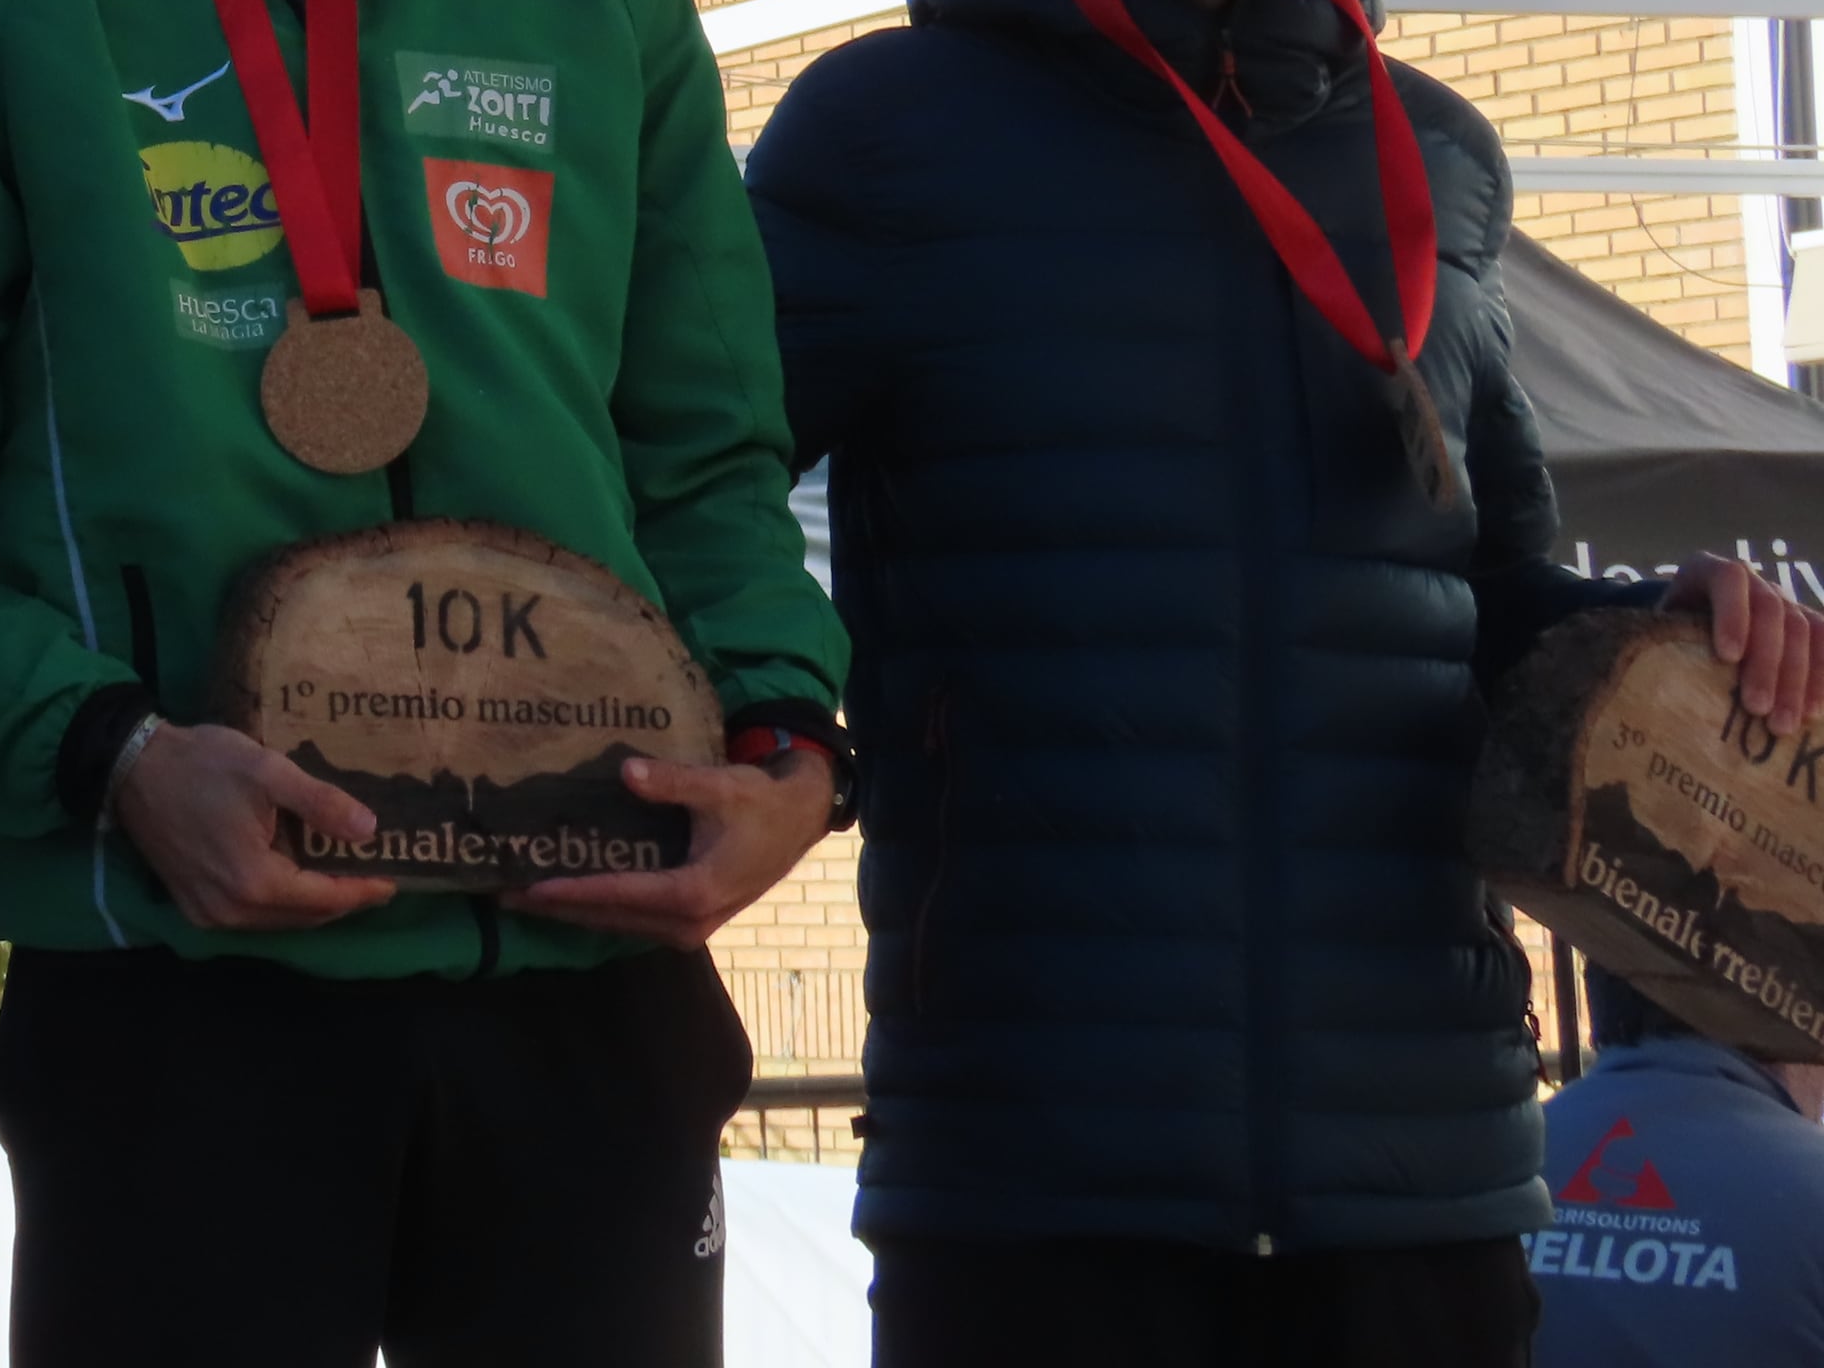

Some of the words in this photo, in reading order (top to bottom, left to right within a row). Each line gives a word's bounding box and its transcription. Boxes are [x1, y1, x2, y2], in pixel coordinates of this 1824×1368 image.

[463, 69, 553, 93] ATLETISMO
[467, 85, 551, 127] ZOITI
[469, 115, 547, 145] Huesca
[406, 582, 547, 661] 10K
[329, 687, 465, 724] premio
[479, 695, 672, 731] masculino
[1648, 746, 1751, 835] premio
[1749, 821, 1824, 898] masc
[1552, 1207, 1702, 1237] GRISOLUTIONS
